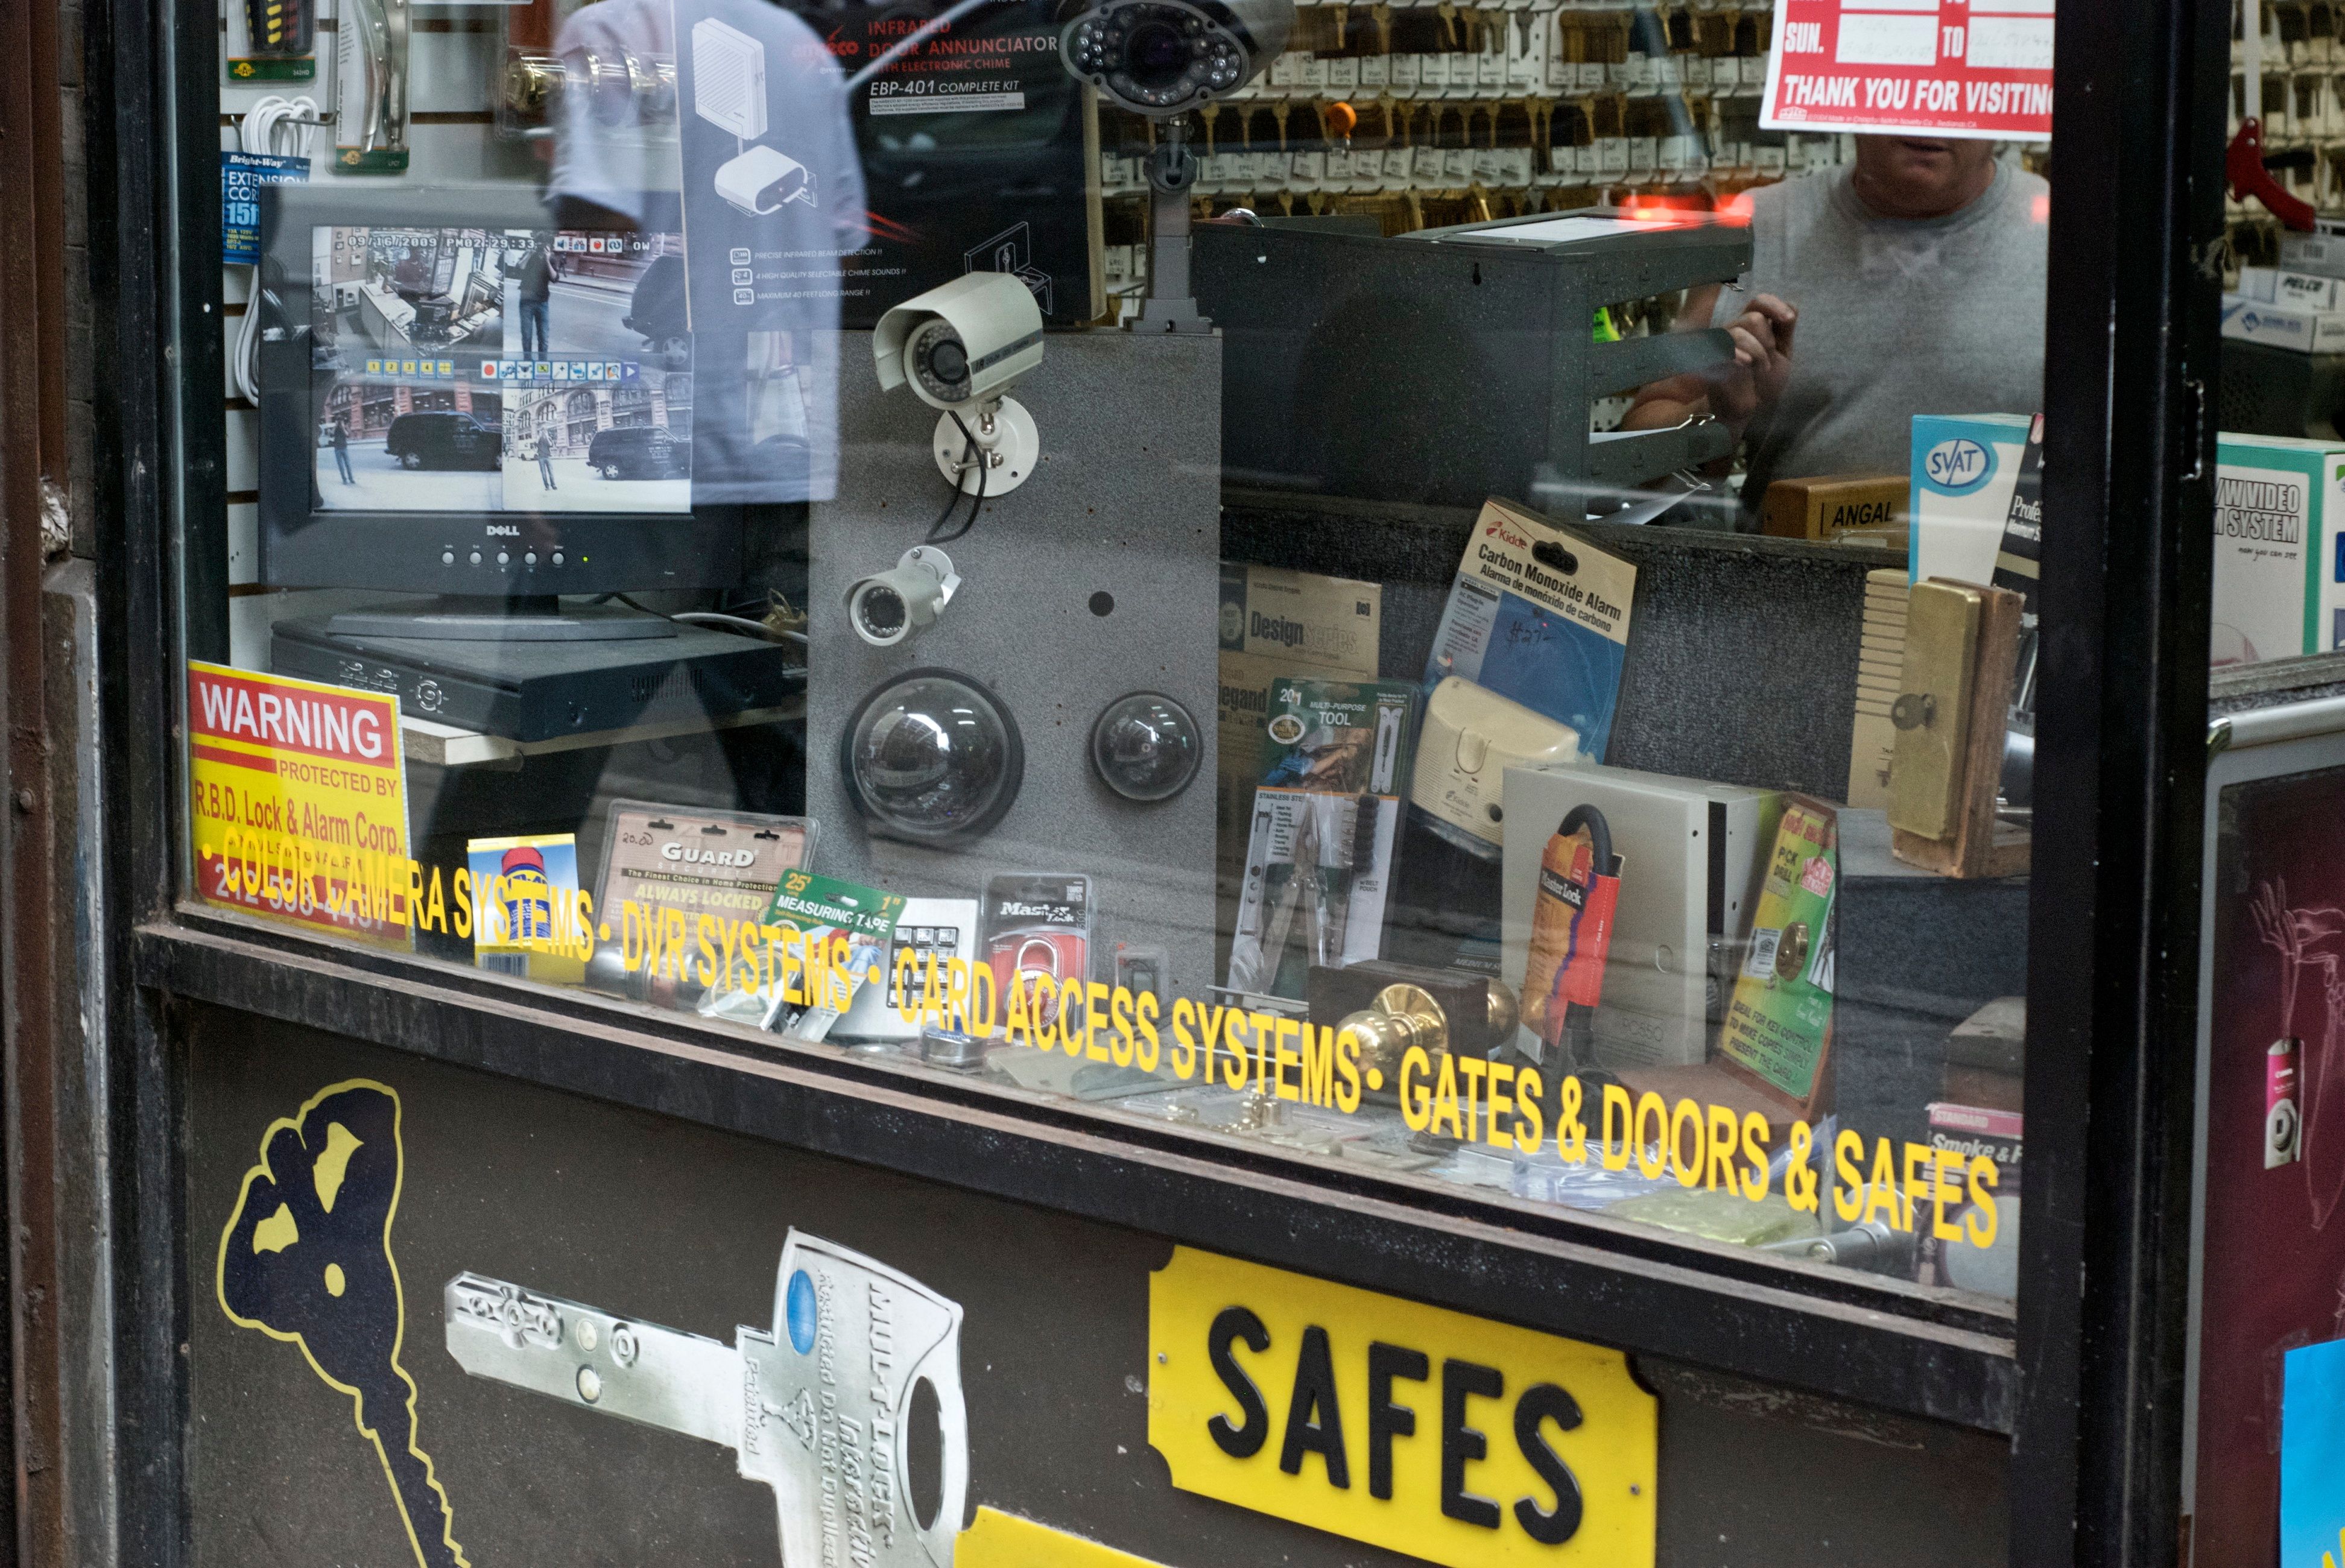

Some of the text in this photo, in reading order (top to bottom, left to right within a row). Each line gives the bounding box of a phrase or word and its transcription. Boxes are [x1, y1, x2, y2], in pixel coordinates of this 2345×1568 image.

[869, 17, 952, 36] INFRARED
[1784, 22, 1824, 54] SUN.
[1942, 26, 1964, 58] TO
[928, 36, 1058, 55] ANNUNCIATOR
[902, 60, 972, 72] ELECTRONIC
[974, 58, 1011, 69] CHIME
[870, 80, 1020, 96] EBP-401 COMPLETE KIT
[1785, 75, 1861, 107] THANK
[1865, 77, 1911, 110] YOU
[1913, 80, 1960, 113] FOR
[229, 154, 283, 169] Bright-Way
[228, 186, 259, 202] COR
[1931, 449, 1979, 475] SVAT
[2245, 480, 2300, 513] VIDEO
[1831, 501, 1894, 528] ANGAL
[2227, 508, 2299, 544] SYSTEM
[486, 525, 520, 536] DELL
[1498, 528, 1528, 550] Kidde
[1478, 543, 1622, 621] Carbon Monoxide Alarm
[1479, 563, 1612, 633] Alarma de monóxido de carbono
[1251, 610, 1305, 648] Design
[200, 681, 383, 760] WARNING
[1309, 701, 1367, 712] MULTI-PURPOSE
[1319, 711, 1352, 727] TOOL
[279, 760, 397, 798] PROTECTED BY
[1258, 792, 1290, 802] STAINLESS
[195, 779, 241, 824] R.B.D.
[244, 789, 282, 832] Lock
[286, 798, 299, 836] &
[302, 802, 352, 846] Alarm
[355, 811, 403, 856] Corp.
[628, 869, 642, 877] The
[645, 871, 671, 881] Finest
[672, 874, 700, 885] Choice
[712, 878, 734, 888] Home
[736, 880, 777, 893] Protection
[657, 861, 754, 877] SECURITY
[635, 884, 763, 911] ALWAYS LOCKED
[999, 901, 1070, 916] Master
[1563, 883, 1581, 906] Lock
[776, 895, 854, 924] MEASURING
[856, 913, 890, 933] TAPE
[224, 826, 1999, 1249] COLOR CAMERA SYSTEMS DVR SYSTEMS CARD ACCESS SYSTEMS GATES & DOORS & SAFES
[1932, 1133, 2010, 1163] Smoke &
[743, 1357, 761, 1456] Patented
[819, 1391, 837, 1424] Do
[869, 1282, 893, 1534] MUL-T-LOCK
[1207, 1304, 1584, 1546] SAFES
[820, 1429, 838, 1473] Not
[838, 1414, 879, 1568] Interactiv
[820, 1476, 839, 1568] Duplicat
